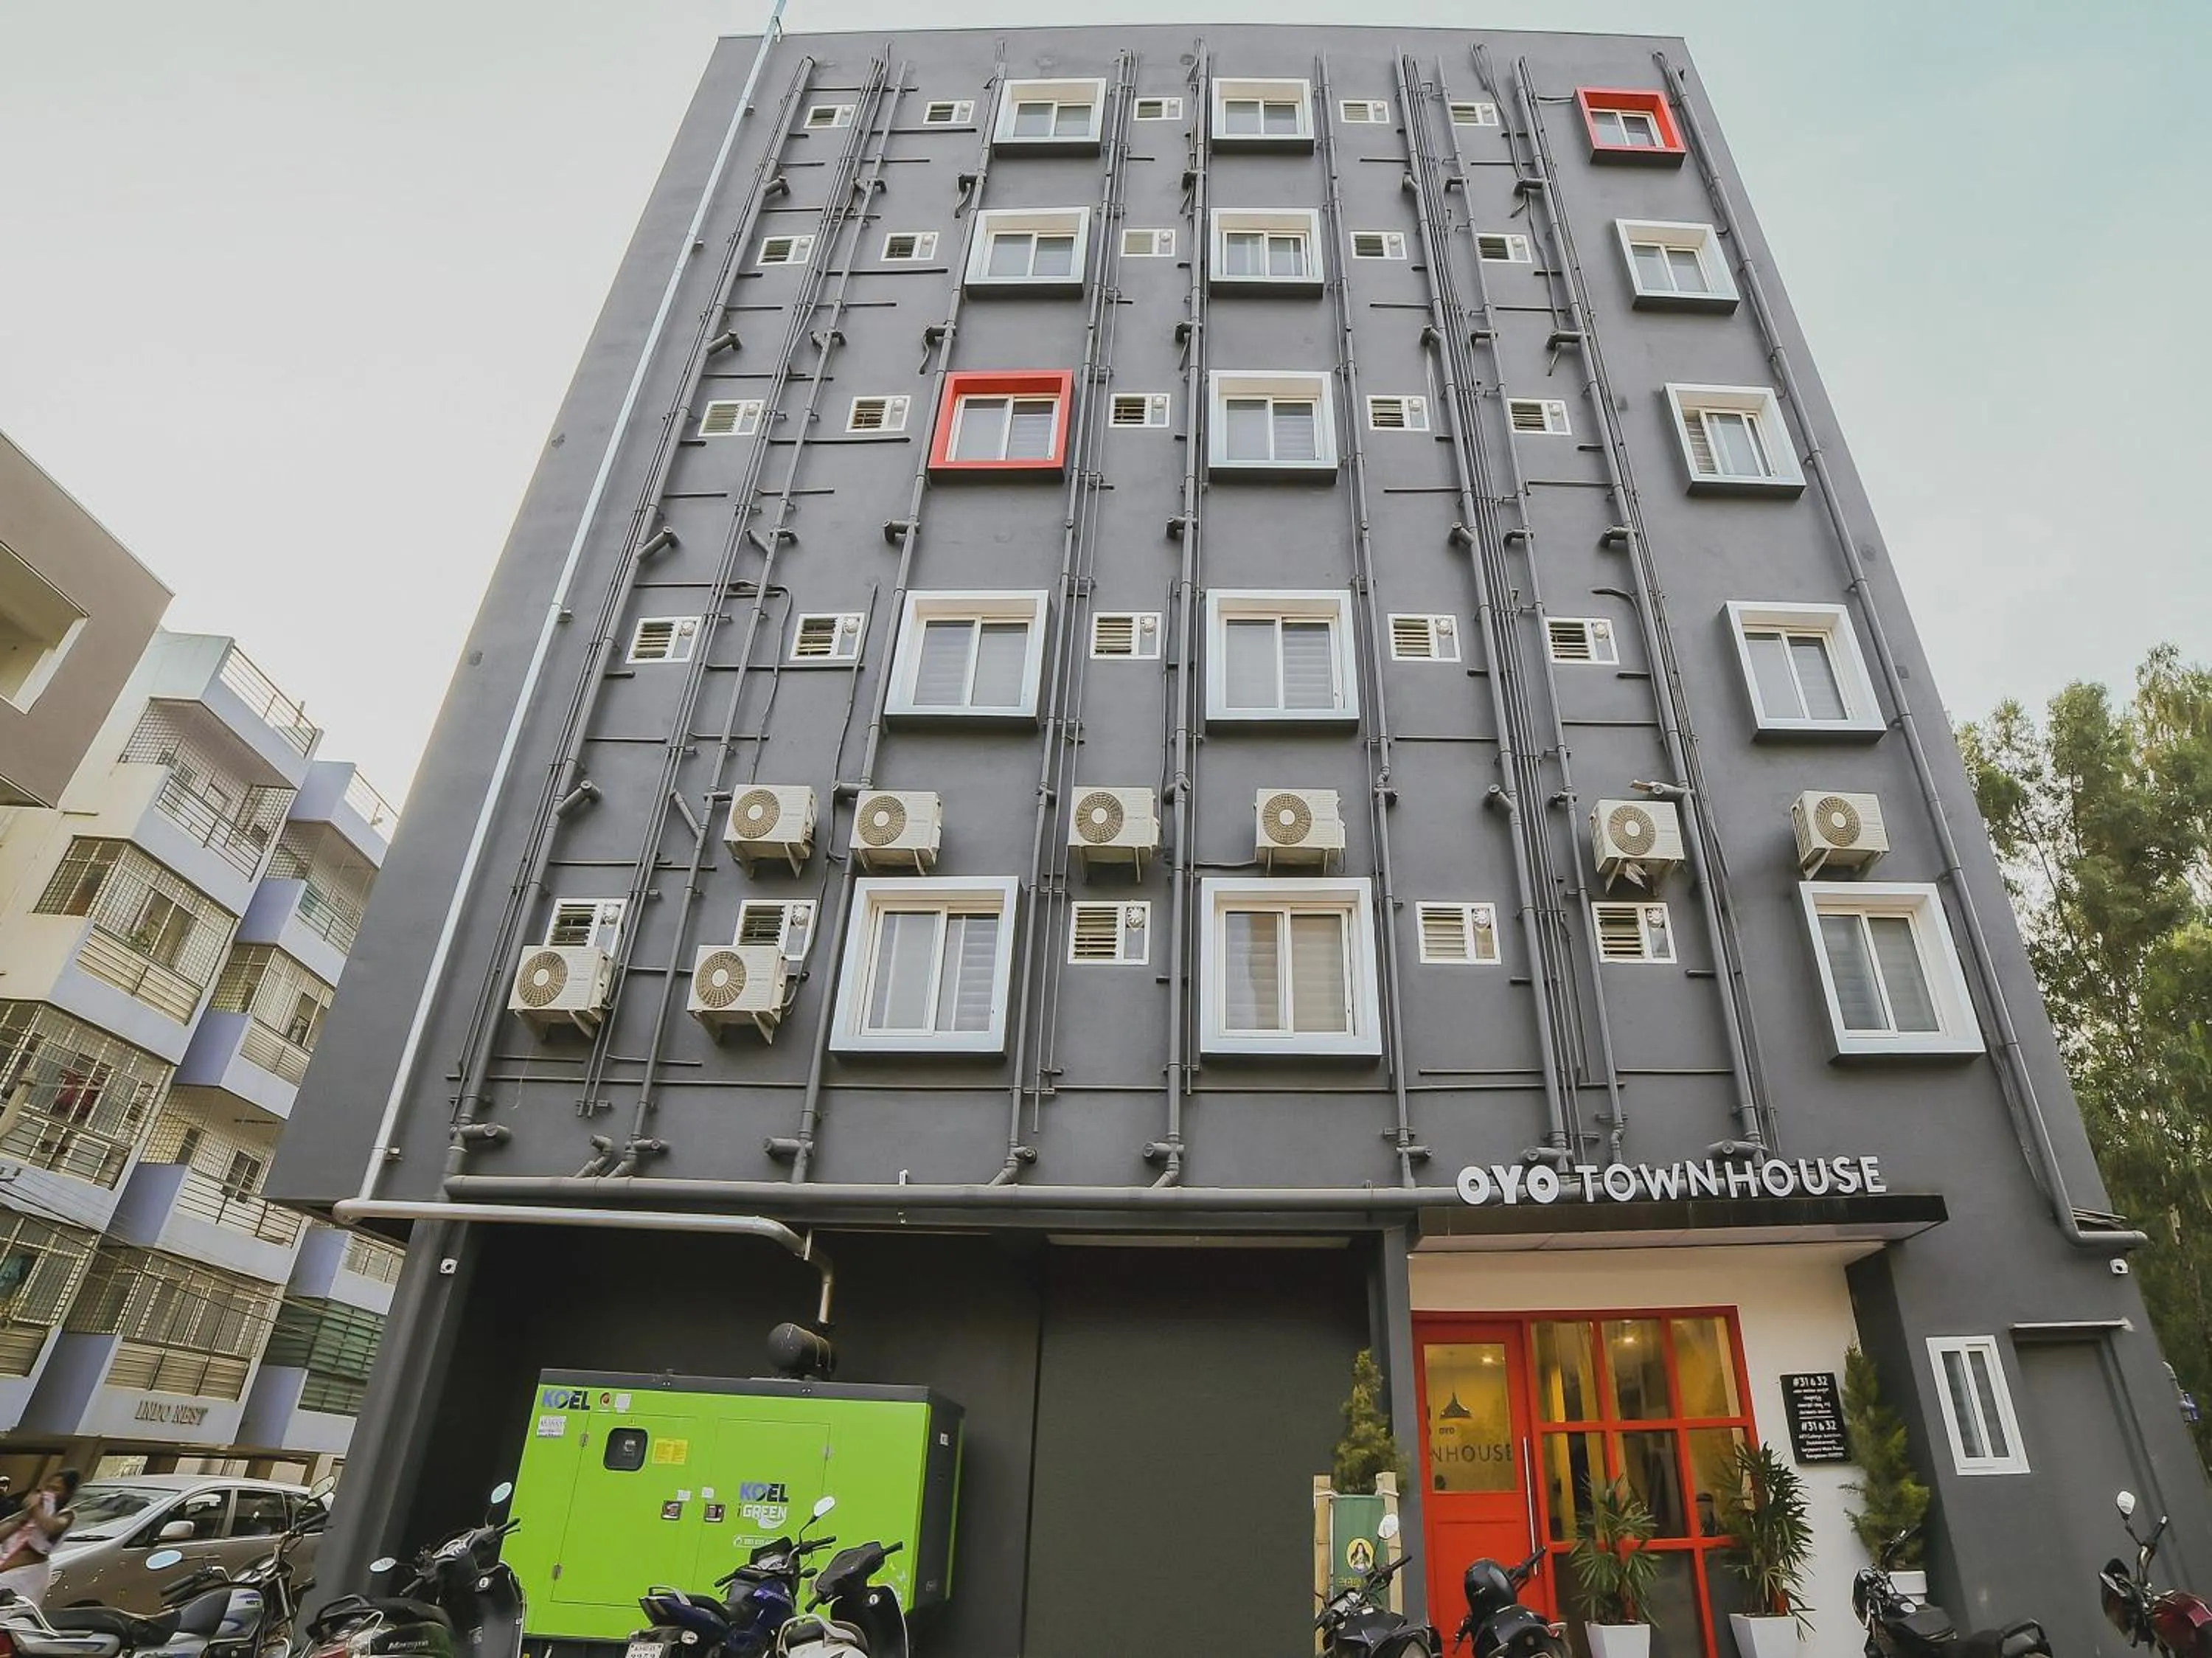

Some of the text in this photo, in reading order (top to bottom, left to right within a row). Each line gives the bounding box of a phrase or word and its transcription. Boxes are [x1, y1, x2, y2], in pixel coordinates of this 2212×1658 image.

[1457, 1156, 1888, 1204] OYO TOWNHOUSE
[543, 1390, 591, 1410] KOEL
[1439, 1426, 1455, 1435] OYO
[740, 1482, 789, 1502] KOEL
